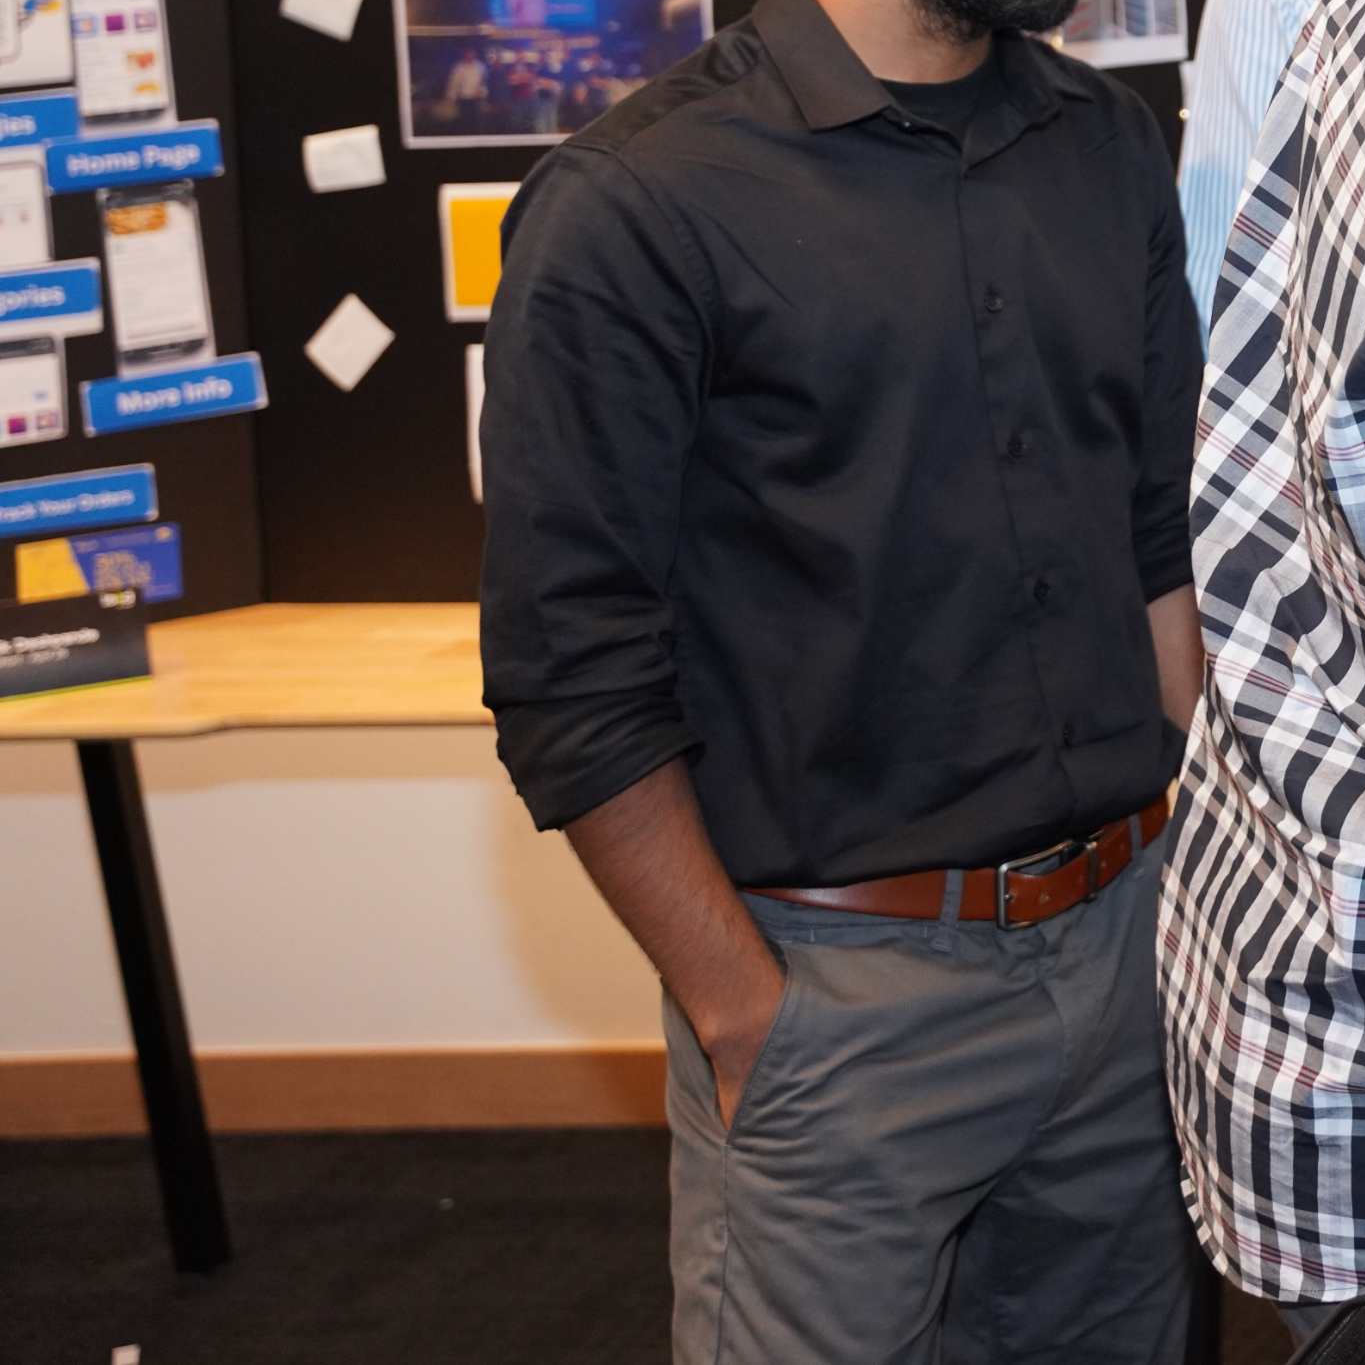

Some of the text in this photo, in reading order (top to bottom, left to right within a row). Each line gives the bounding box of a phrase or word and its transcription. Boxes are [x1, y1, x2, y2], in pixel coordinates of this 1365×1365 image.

[67, 144, 200, 177] Home Page
[116, 376, 233, 416] More Info
